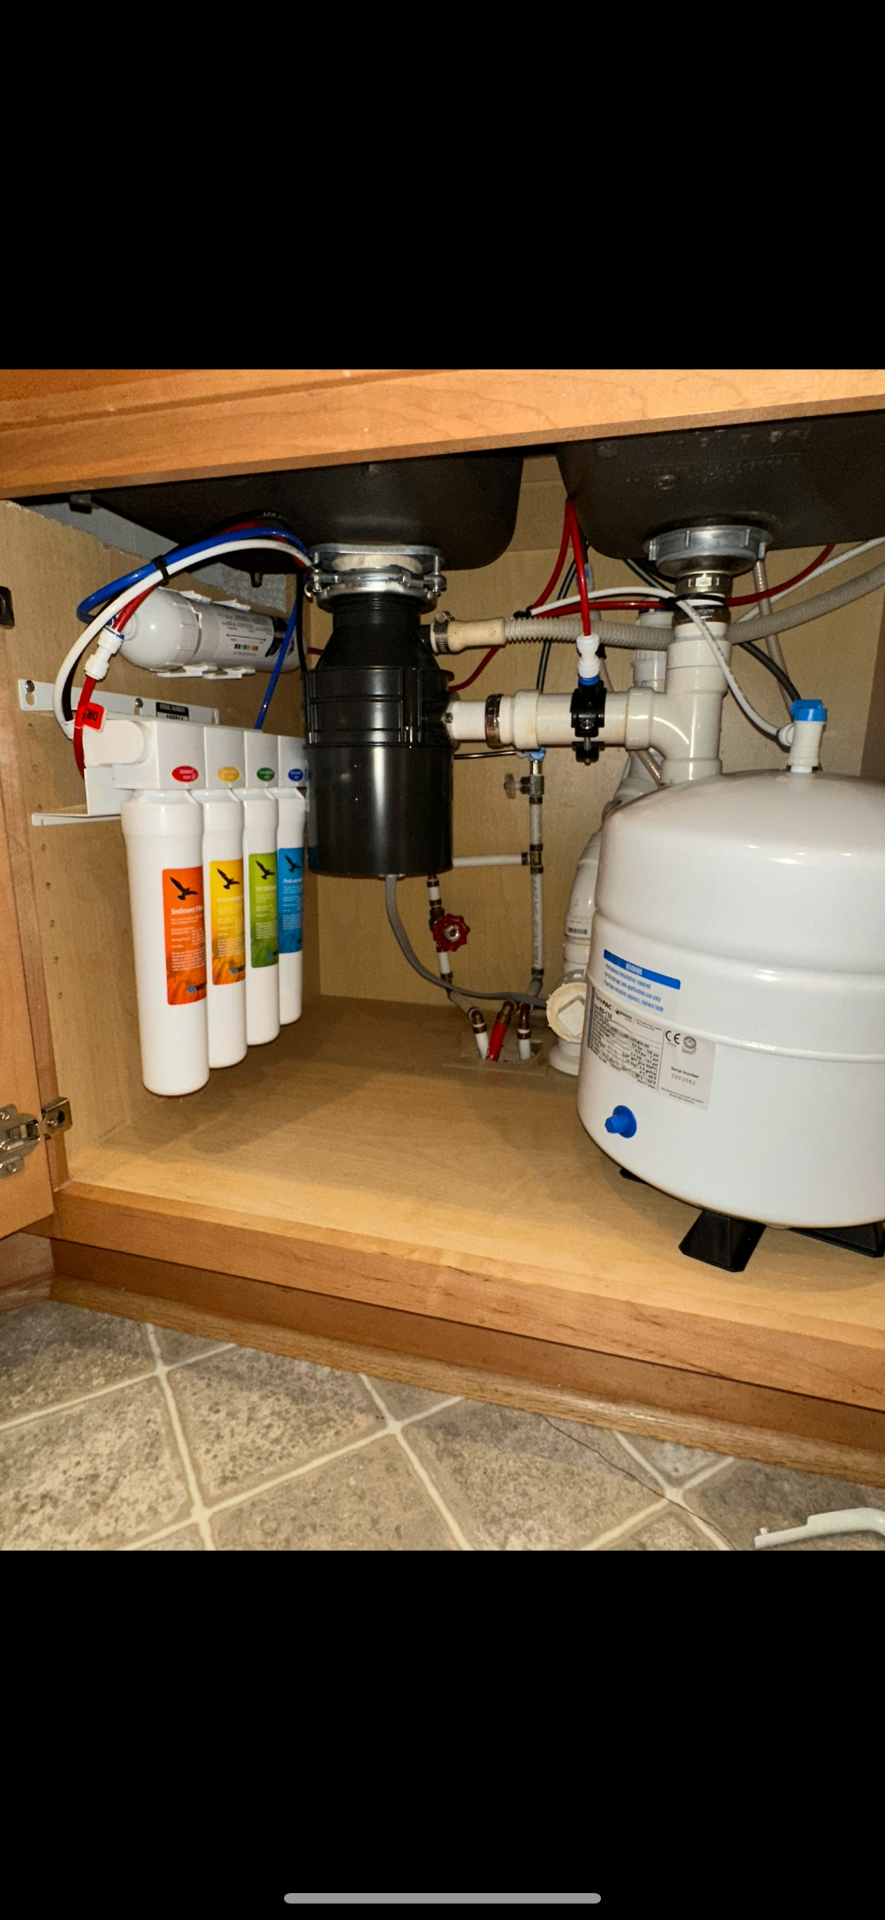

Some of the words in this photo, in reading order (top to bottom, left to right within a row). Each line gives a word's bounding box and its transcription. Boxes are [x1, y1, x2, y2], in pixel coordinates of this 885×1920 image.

[170, 907, 195, 916] Sediment
[665, 1030, 681, 1045] CE
[671, 1066, 682, 1074] Serial
[683, 1070, 700, 1079] Number
